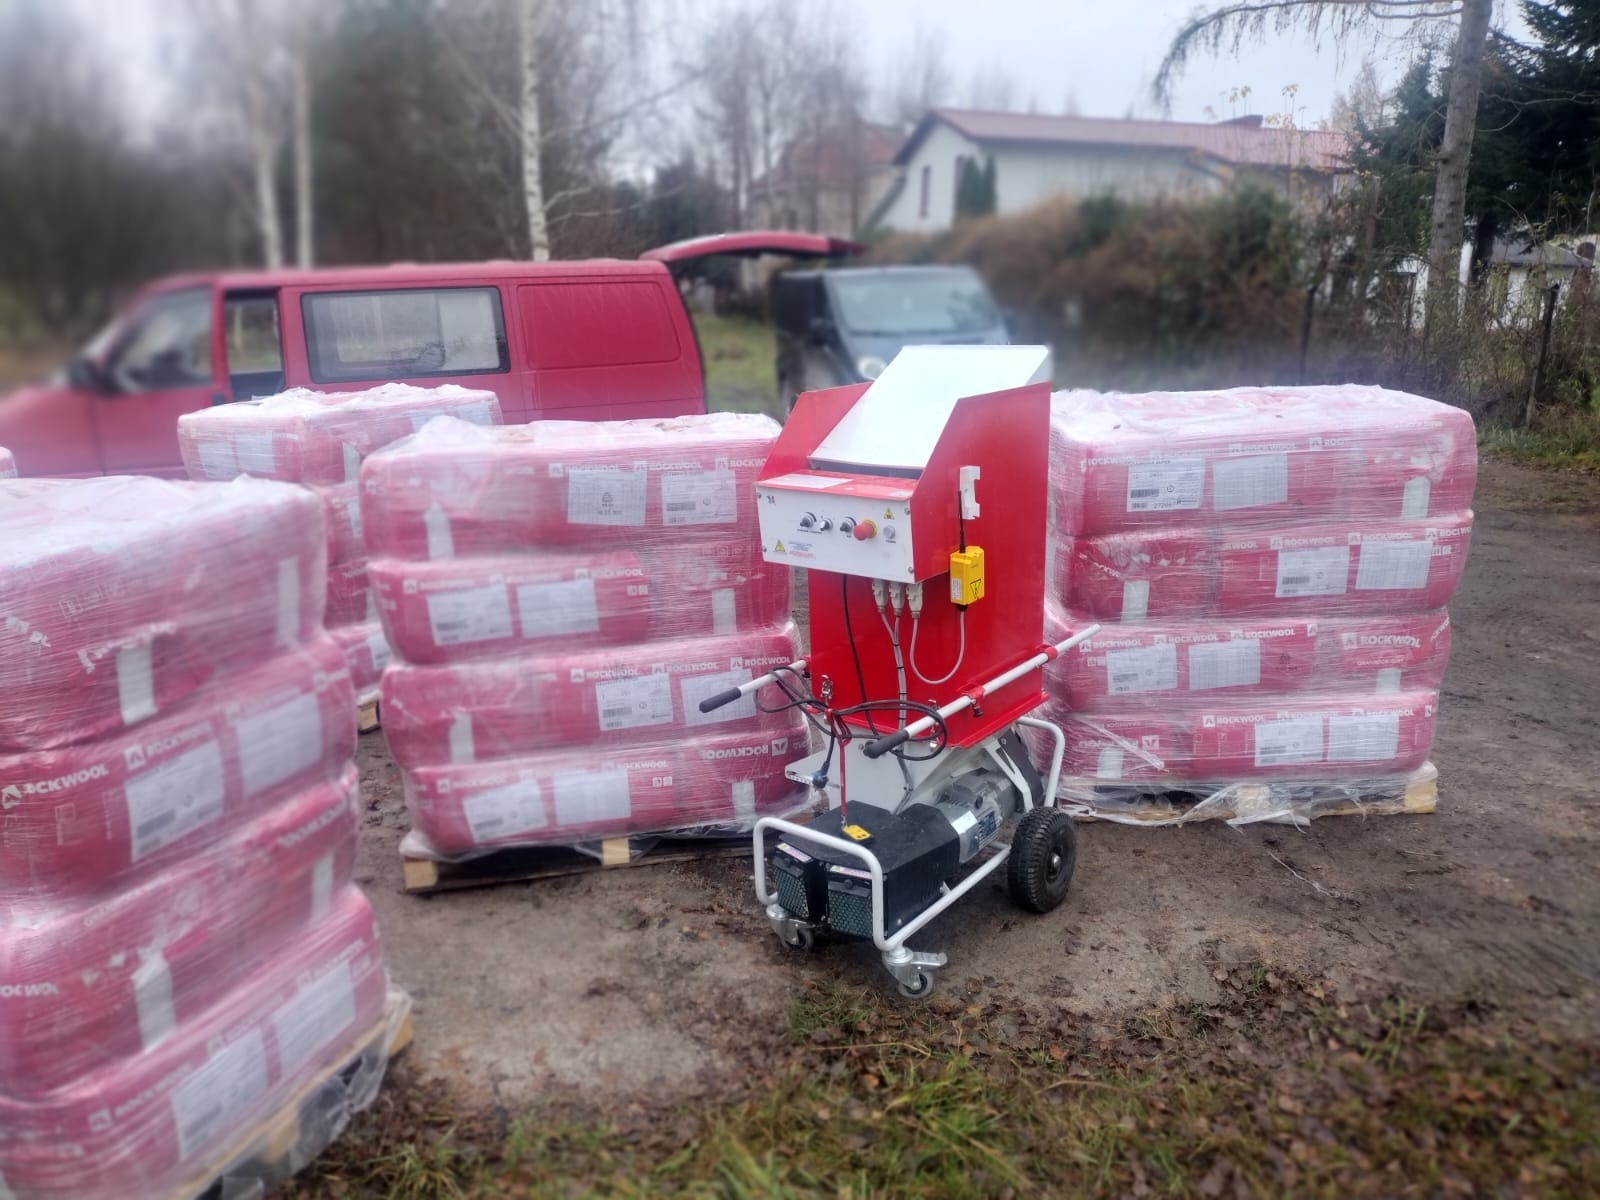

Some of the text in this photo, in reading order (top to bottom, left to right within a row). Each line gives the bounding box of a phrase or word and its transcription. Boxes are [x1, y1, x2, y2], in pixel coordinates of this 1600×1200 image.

[1168, 632, 1218, 644] ROCKWOOL
[1244, 628, 1296, 640] ROCKWOOL
[1360, 634, 1421, 649] ROCKWOOL
[666, 661, 719, 674] ROCKWOOL
[744, 656, 790, 668] ROCKWOOL
